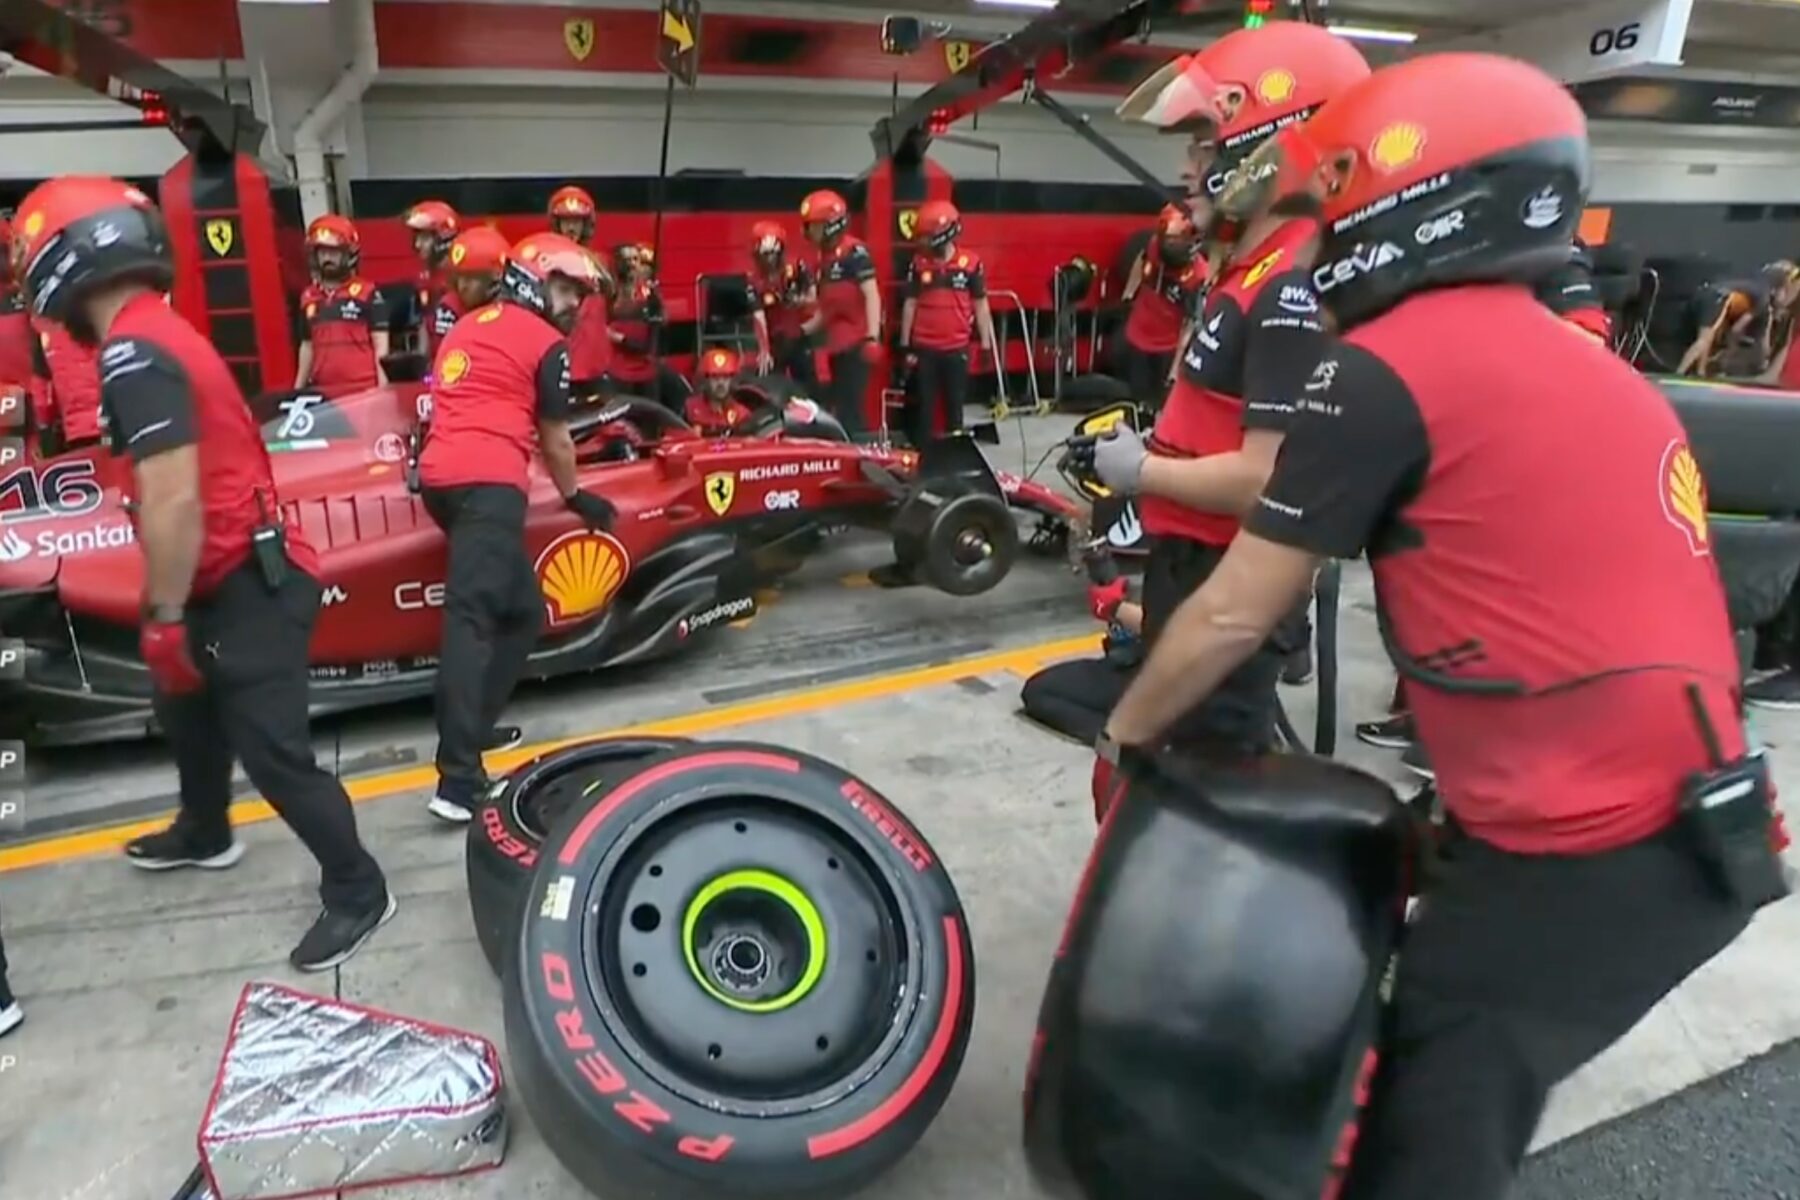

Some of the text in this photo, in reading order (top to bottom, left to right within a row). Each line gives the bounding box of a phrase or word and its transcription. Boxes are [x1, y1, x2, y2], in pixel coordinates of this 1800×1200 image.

[1589, 22, 1641, 56] 06
[1225, 121, 1274, 148] RICHARD
[1333, 172, 1450, 234] RICHARD MILLE
[739, 459, 841, 482] RICHARD MILLE
[0, 459, 104, 524] 16
[394, 582, 446, 610] CE
[689, 596, 754, 632] Snapdragon
[541, 952, 736, 1162] P ZERO
